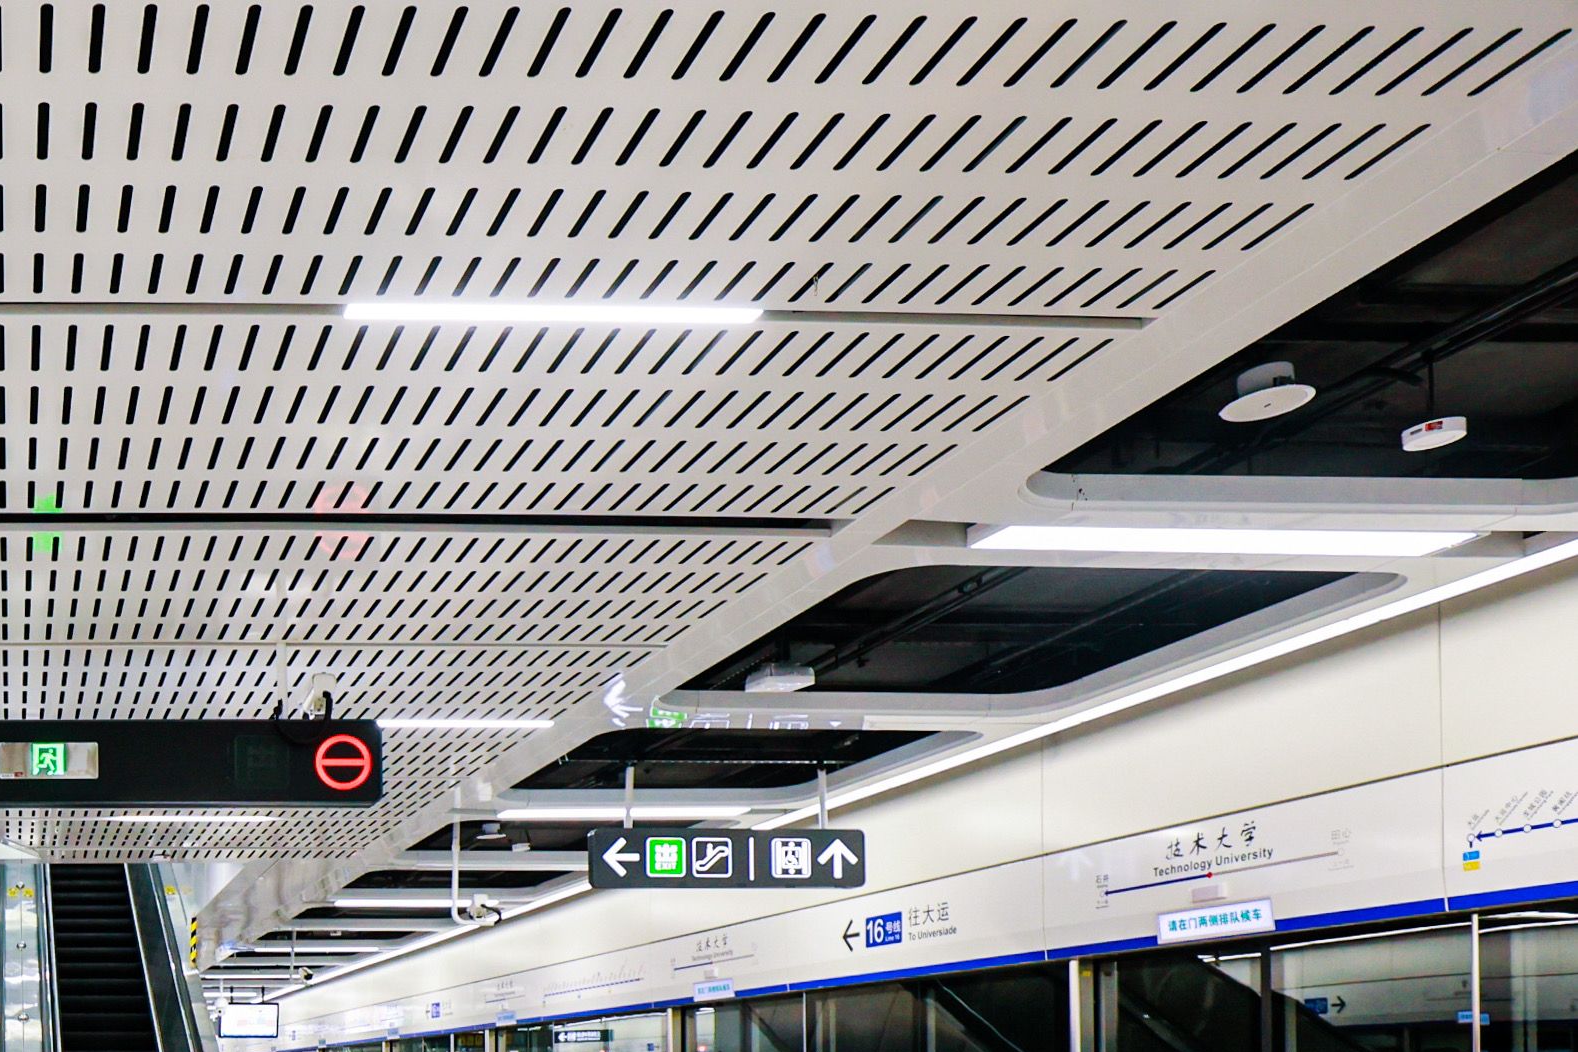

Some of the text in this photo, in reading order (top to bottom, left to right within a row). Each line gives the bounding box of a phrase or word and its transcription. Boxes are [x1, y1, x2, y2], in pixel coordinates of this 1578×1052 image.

[1166, 820, 1257, 861] 技术大学
[1331, 827, 1352, 840] 田心
[1153, 847, 1274, 877] Technology University
[908, 902, 950, 926] 往大运
[1168, 907, 1262, 932] 请在门两侧排队候车
[908, 926, 958, 940] To Universiade
